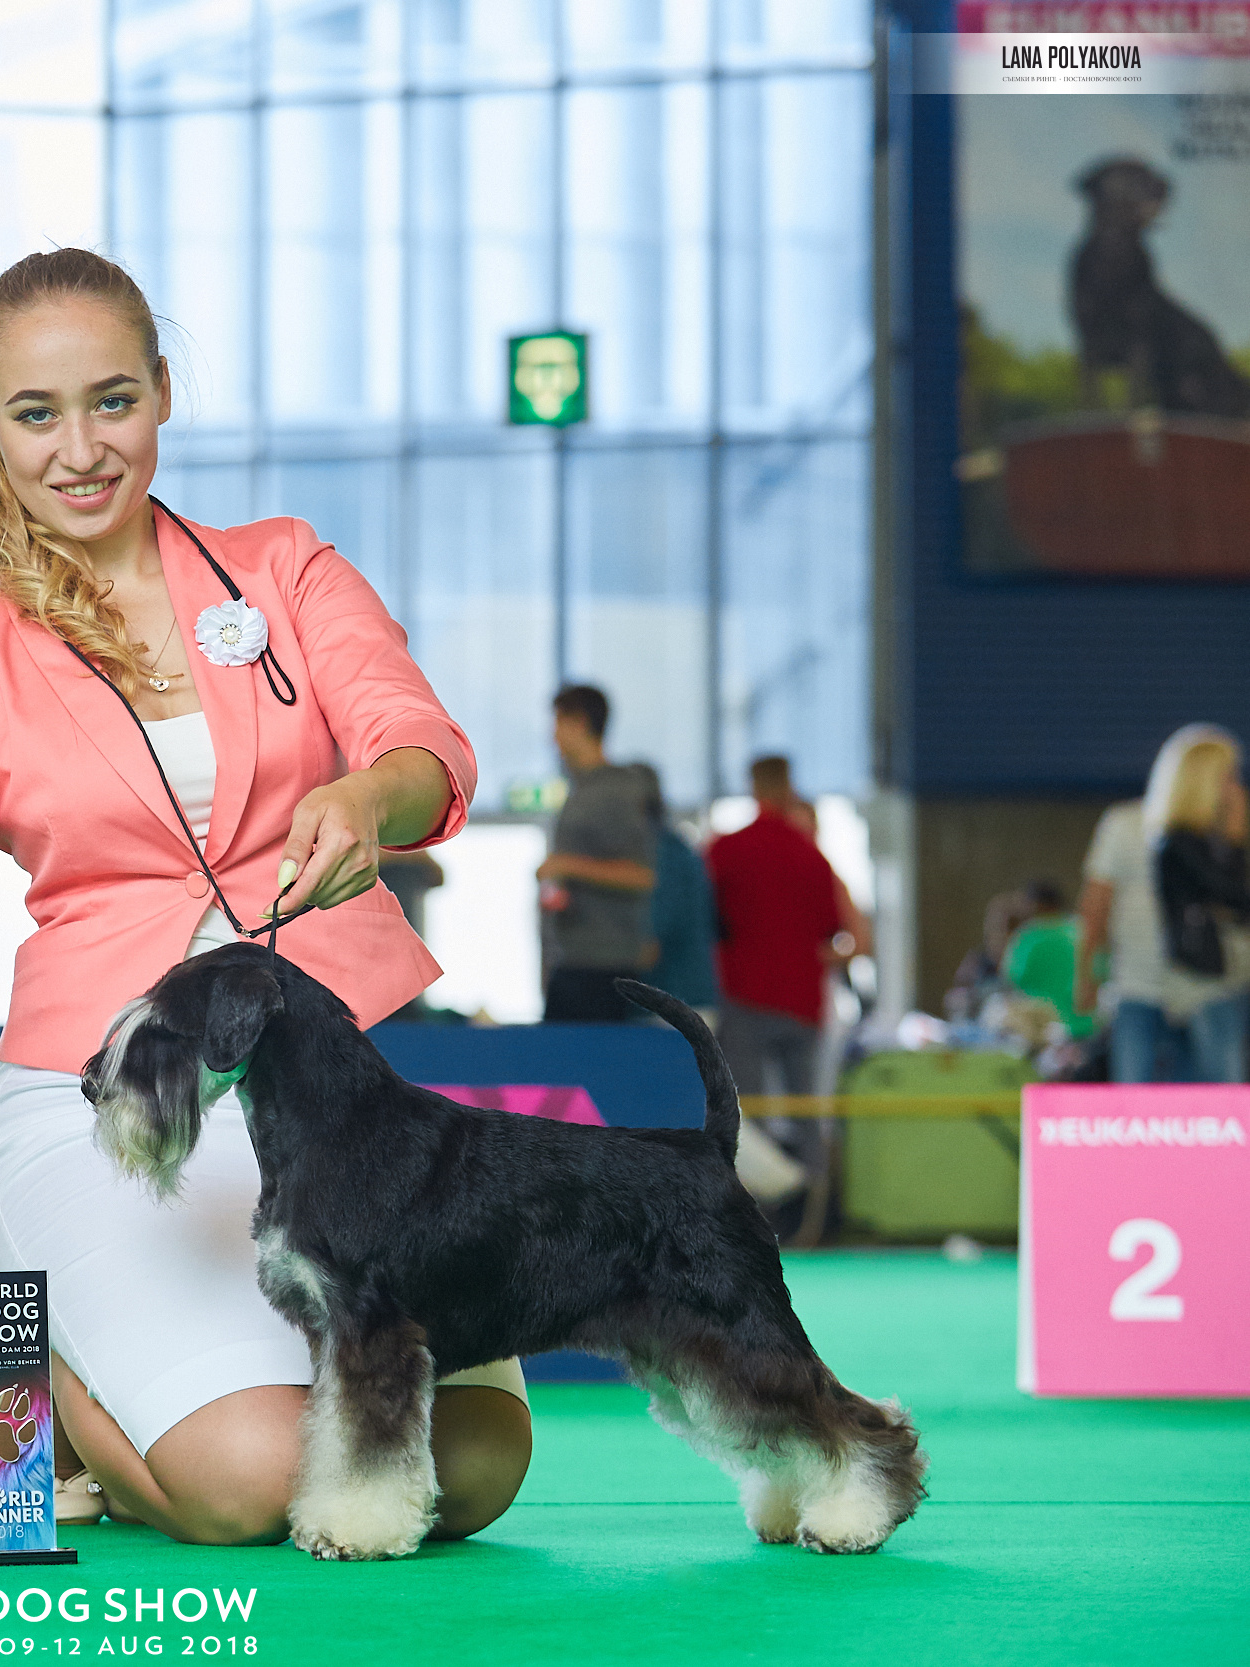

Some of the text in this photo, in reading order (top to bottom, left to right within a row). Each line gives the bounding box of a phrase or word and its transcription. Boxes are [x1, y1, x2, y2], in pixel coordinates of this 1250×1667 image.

[1058, 1116, 1246, 1147] EUKANUBA
[1108, 1217, 1184, 1323] 2
[22, 1345, 40, 1353] 2018
